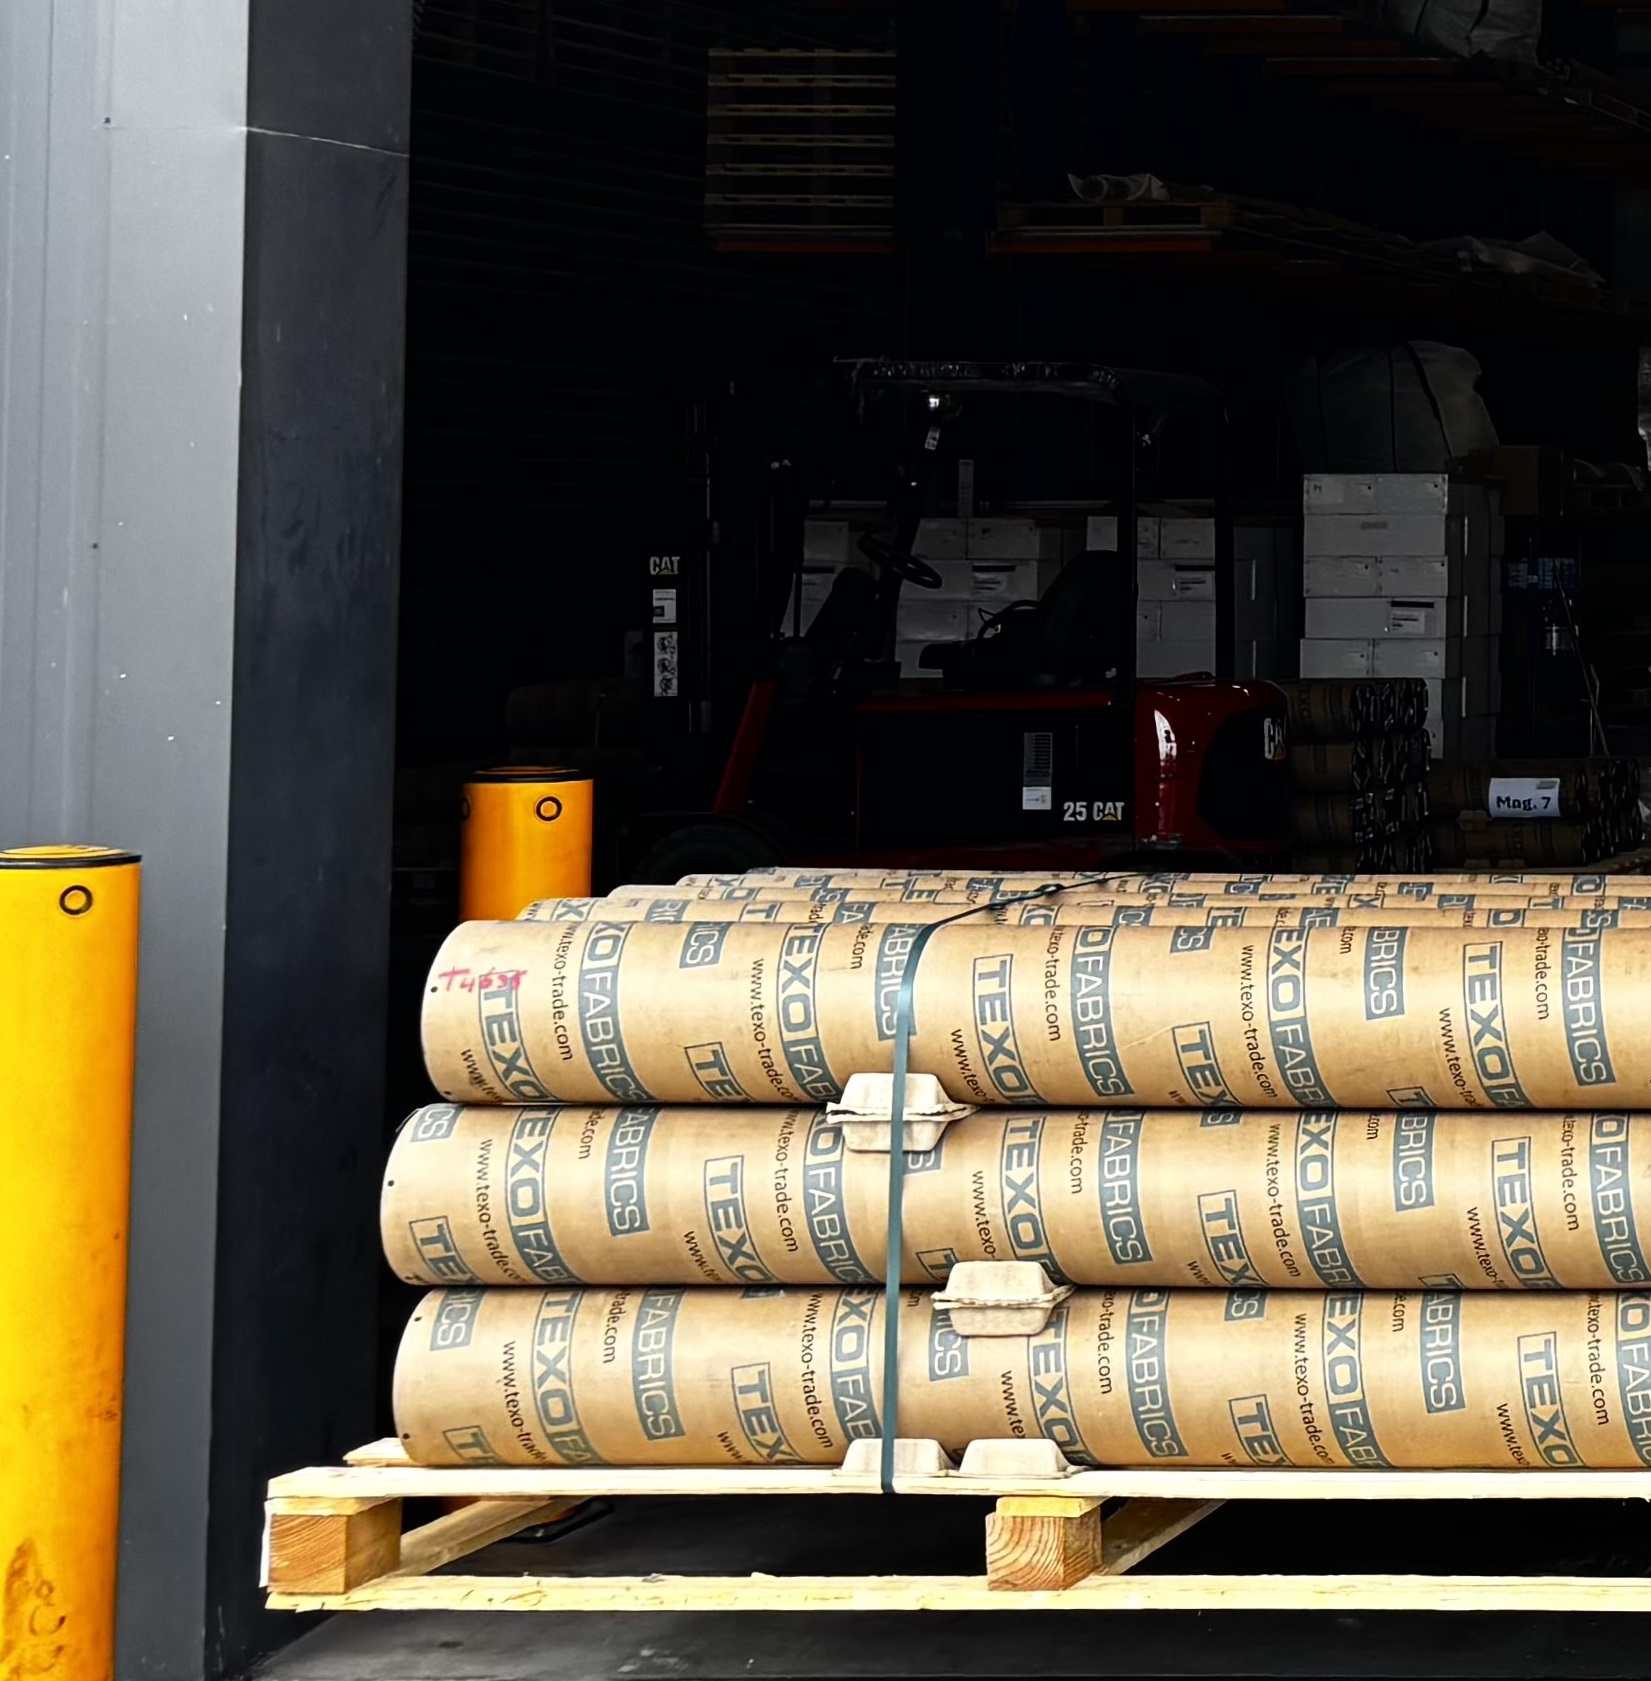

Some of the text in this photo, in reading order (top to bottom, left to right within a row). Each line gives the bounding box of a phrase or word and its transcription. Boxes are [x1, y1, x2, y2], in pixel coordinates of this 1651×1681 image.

[649, 556, 681, 576] CAT
[1063, 801, 1126, 821] 25 CAT
[977, 958, 1024, 1101] TEXO
[1073, 950, 1126, 1098] FABRICS
[1240, 946, 1280, 1097] www.texo-trade.com
[1369, 929, 1401, 1015] BRICS
[1468, 947, 1511, 1080] TEXO
[1566, 936, 1611, 1083] FABRICS
[1179, 1028, 1238, 1105] TEX
[610, 1110, 646, 1232] ABRICS
[708, 1161, 766, 1283] TEXO
[1004, 1121, 1043, 1251] TEXO
[1103, 1116, 1146, 1262] FABRICS
[1266, 1124, 1301, 1278] www.texo-trade.com
[1301, 1114, 1352, 1287] EXO FABR
[1397, 1114, 1428, 1210] BRICS
[1495, 1141, 1547, 1279] TEXO
[1594, 1144, 1647, 1284] FABRICS
[1205, 1195, 1260, 1288] TEX
[533, 1293, 578, 1428] TEXO
[636, 1291, 679, 1439] FABRICS
[1129, 1313, 1184, 1460] FABRICS
[1327, 1294, 1359, 1398] EXO
[1421, 1293, 1459, 1409] ABRICS
[1522, 1337, 1579, 1468] TEXO
[737, 1375, 788, 1463] TEX
